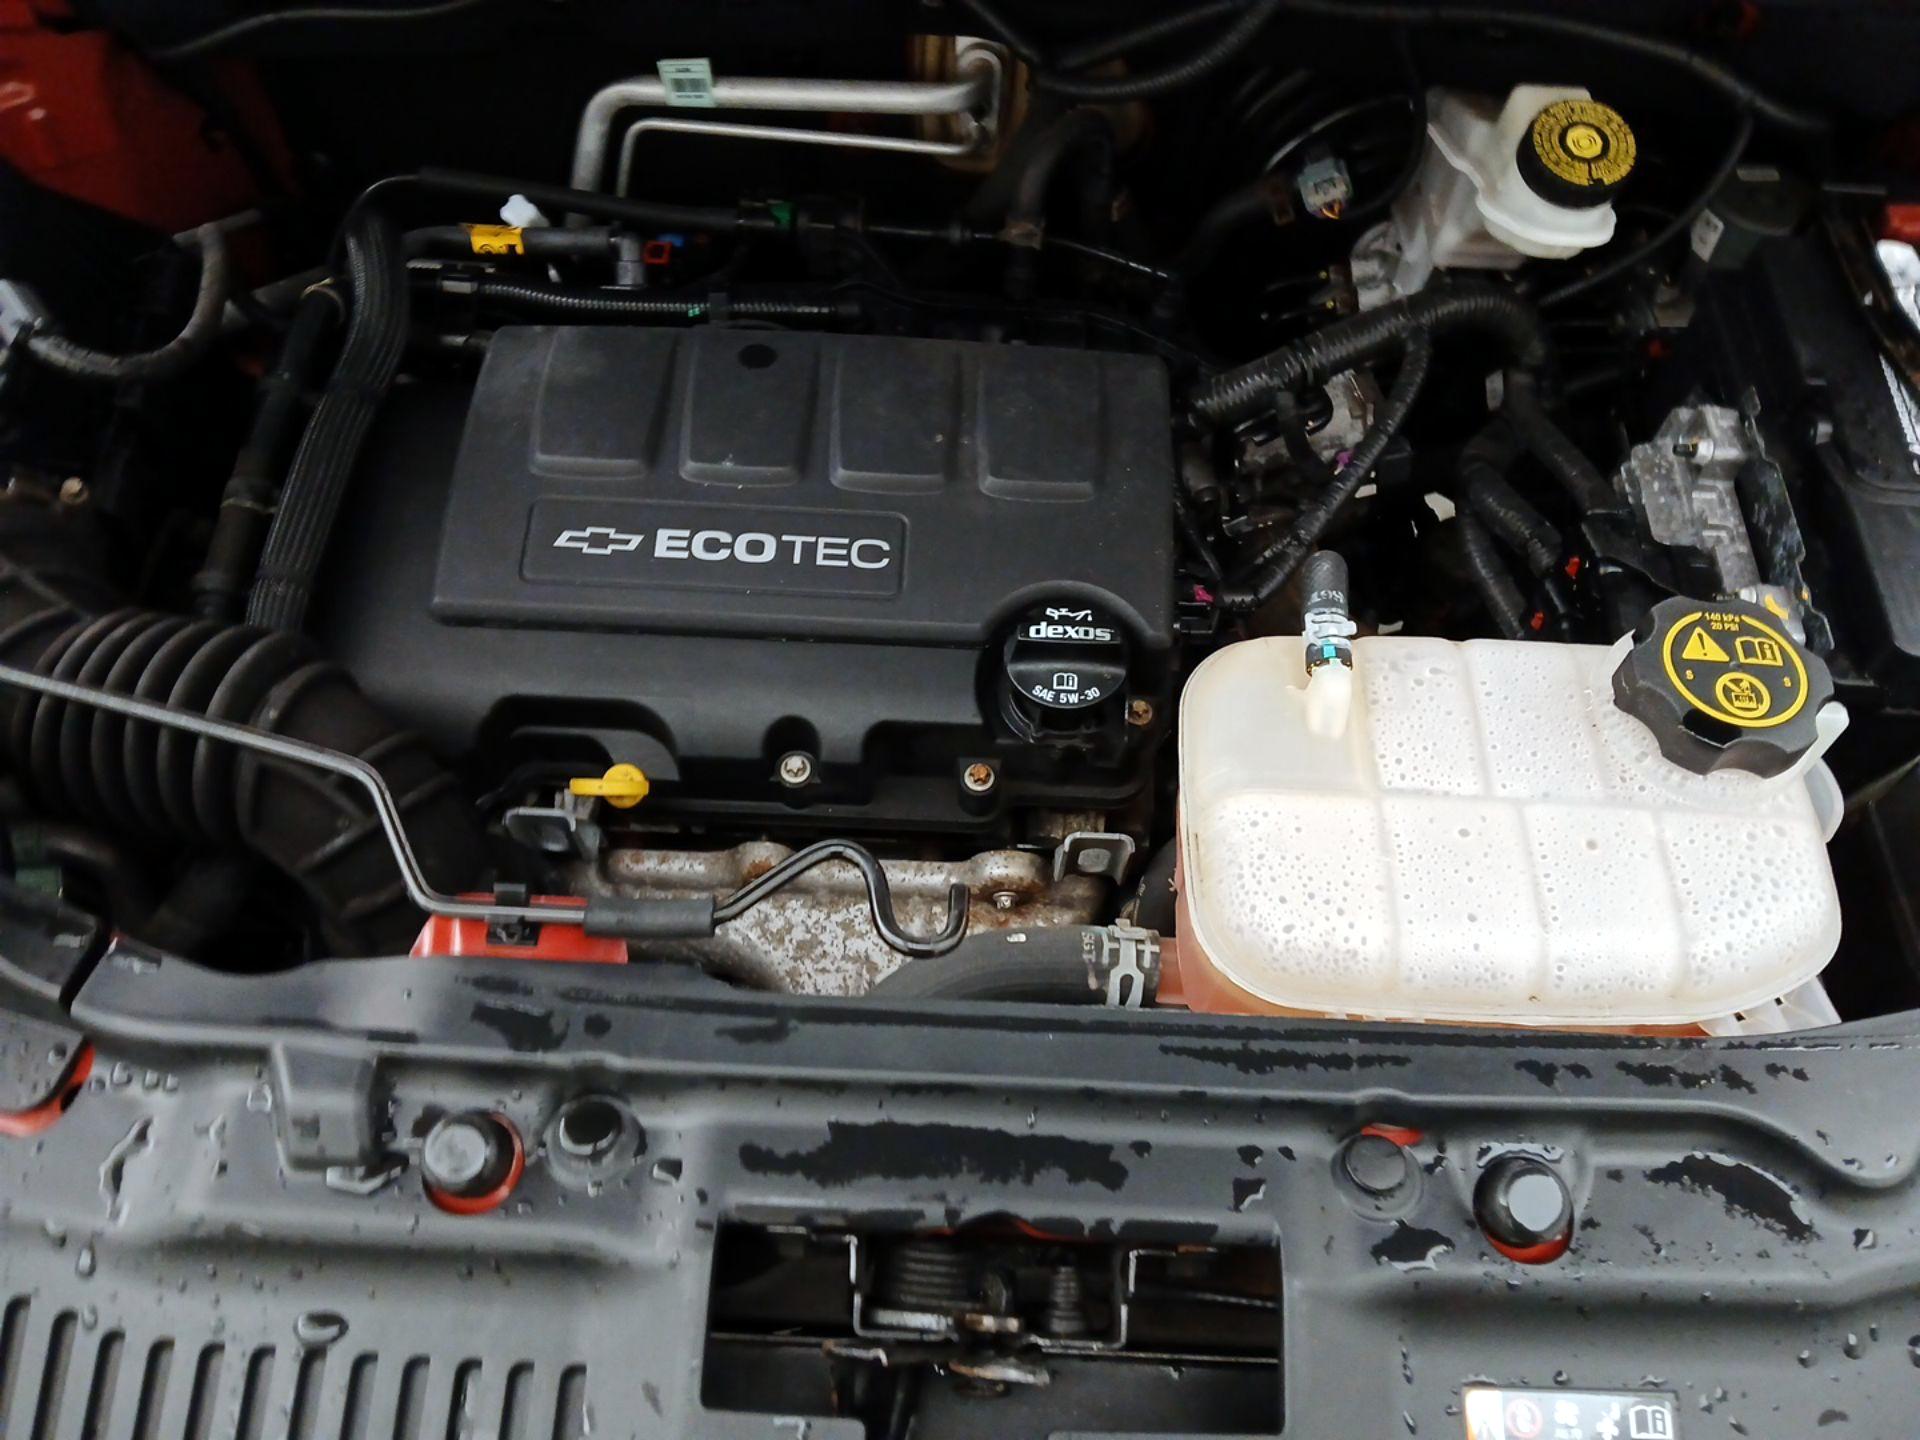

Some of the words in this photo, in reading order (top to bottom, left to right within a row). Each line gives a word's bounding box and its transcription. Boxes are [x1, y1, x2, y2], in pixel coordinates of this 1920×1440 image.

[654, 528, 890, 568] ECOTEC
[1028, 621, 1114, 641] dexos
[1711, 622, 1722, 630] 20
[1031, 685, 1056, 702] SAE
[1059, 687, 1101, 704] 5W-30
